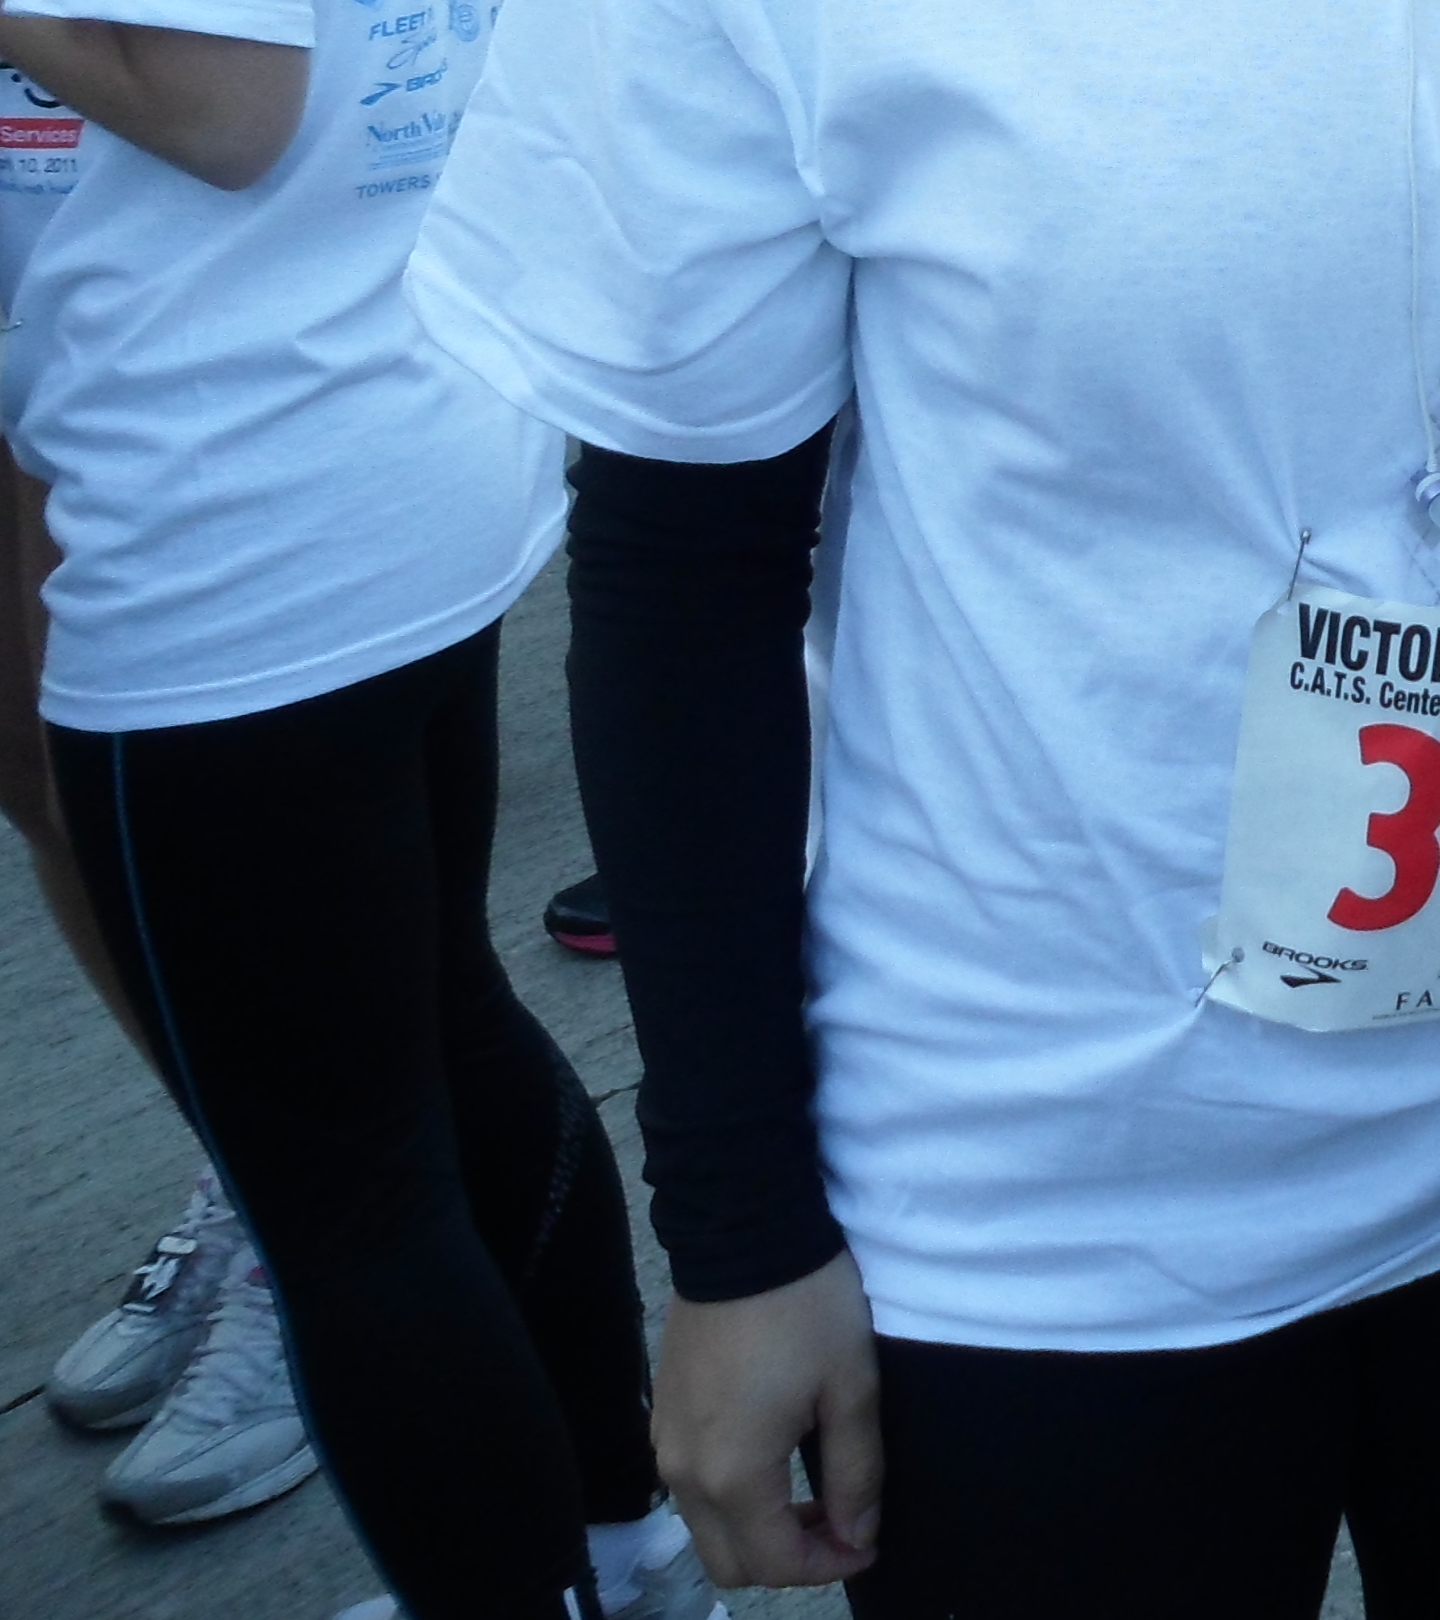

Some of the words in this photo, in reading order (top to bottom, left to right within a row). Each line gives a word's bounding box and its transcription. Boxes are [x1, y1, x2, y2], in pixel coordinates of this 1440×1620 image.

[356, 174, 432, 200] TOWERS
[1289, 661, 1372, 706] C.A.T.S.
[1261, 940, 1369, 972] BROOKS
